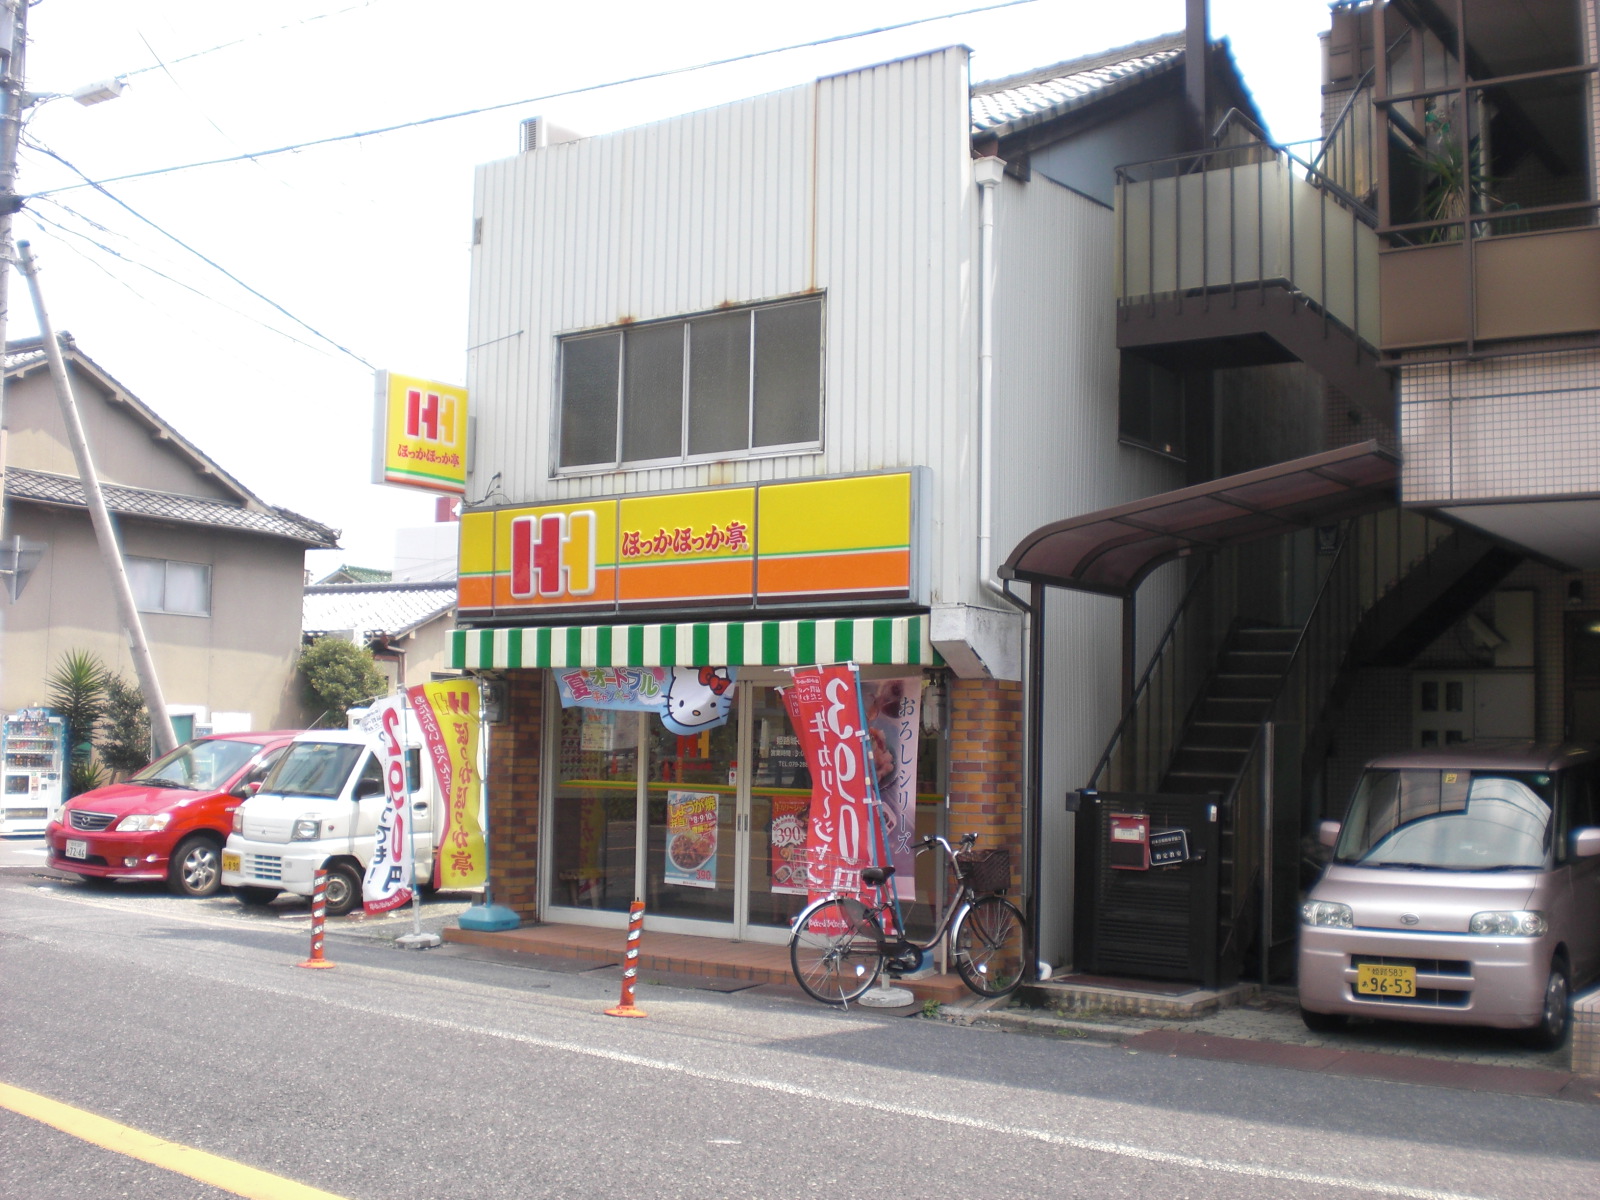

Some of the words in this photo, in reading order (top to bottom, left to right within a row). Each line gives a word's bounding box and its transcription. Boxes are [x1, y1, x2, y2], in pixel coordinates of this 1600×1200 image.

[398, 444, 460, 468] ほっかほっか亭
[622, 521, 748, 556] ほっかほっか亭
[895, 696, 916, 855] おろしシリーズ
[1370, 977, 1412, 994] 96-53
